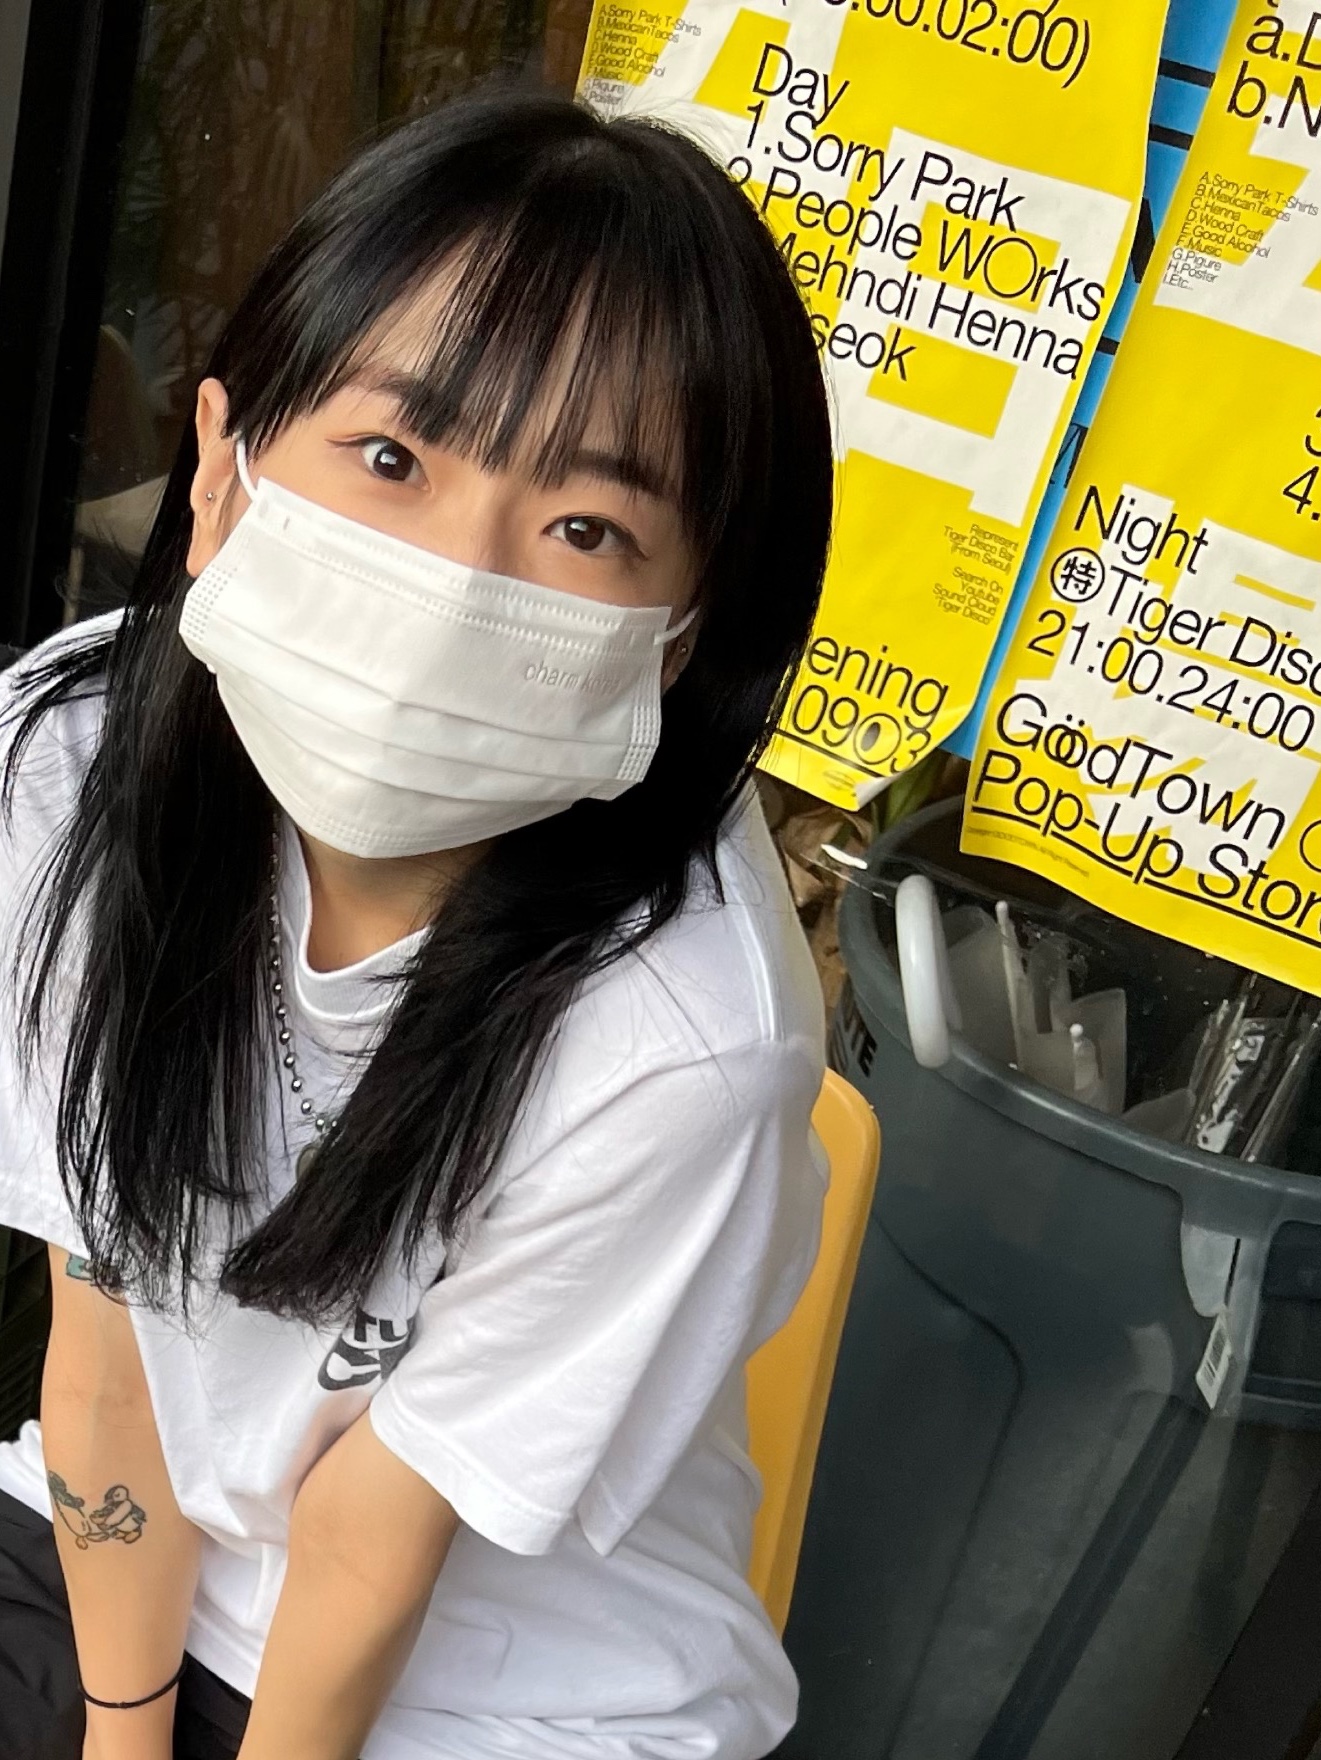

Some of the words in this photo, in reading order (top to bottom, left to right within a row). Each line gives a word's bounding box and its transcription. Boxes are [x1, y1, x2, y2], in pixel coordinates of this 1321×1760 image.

[752, 43, 850, 126] Day
[744, 101, 905, 202] 1.Sorry
[912, 150, 1026, 232] Park
[1199, 171, 1243, 195] A.Sorry
[1244, 183, 1271, 200] Park
[1276, 192, 1319, 216] T-Shirts
[1181, 222, 1226, 245] E.Good
[1226, 236, 1271, 259] Alcohol
[1186, 209, 1234, 233] D.Wood
[1236, 224, 1265, 242] Craft
[1190, 196, 1241, 222] C.Henna
[1167, 261, 1218, 283] H.Poster
[1176, 235, 1223, 258] F.Music
[929, 290, 1084, 380] Henna
[1073, 485, 1209, 576] Night
[953, 566, 988, 587] Search
[990, 580, 1003, 594] On
[1104, 565, 1226, 648] Tiger
[1028, 609, 1315, 752] 21:00.24:00
[974, 749, 1184, 885] Pop-Up
[1197, 843, 1321, 936] Stor
